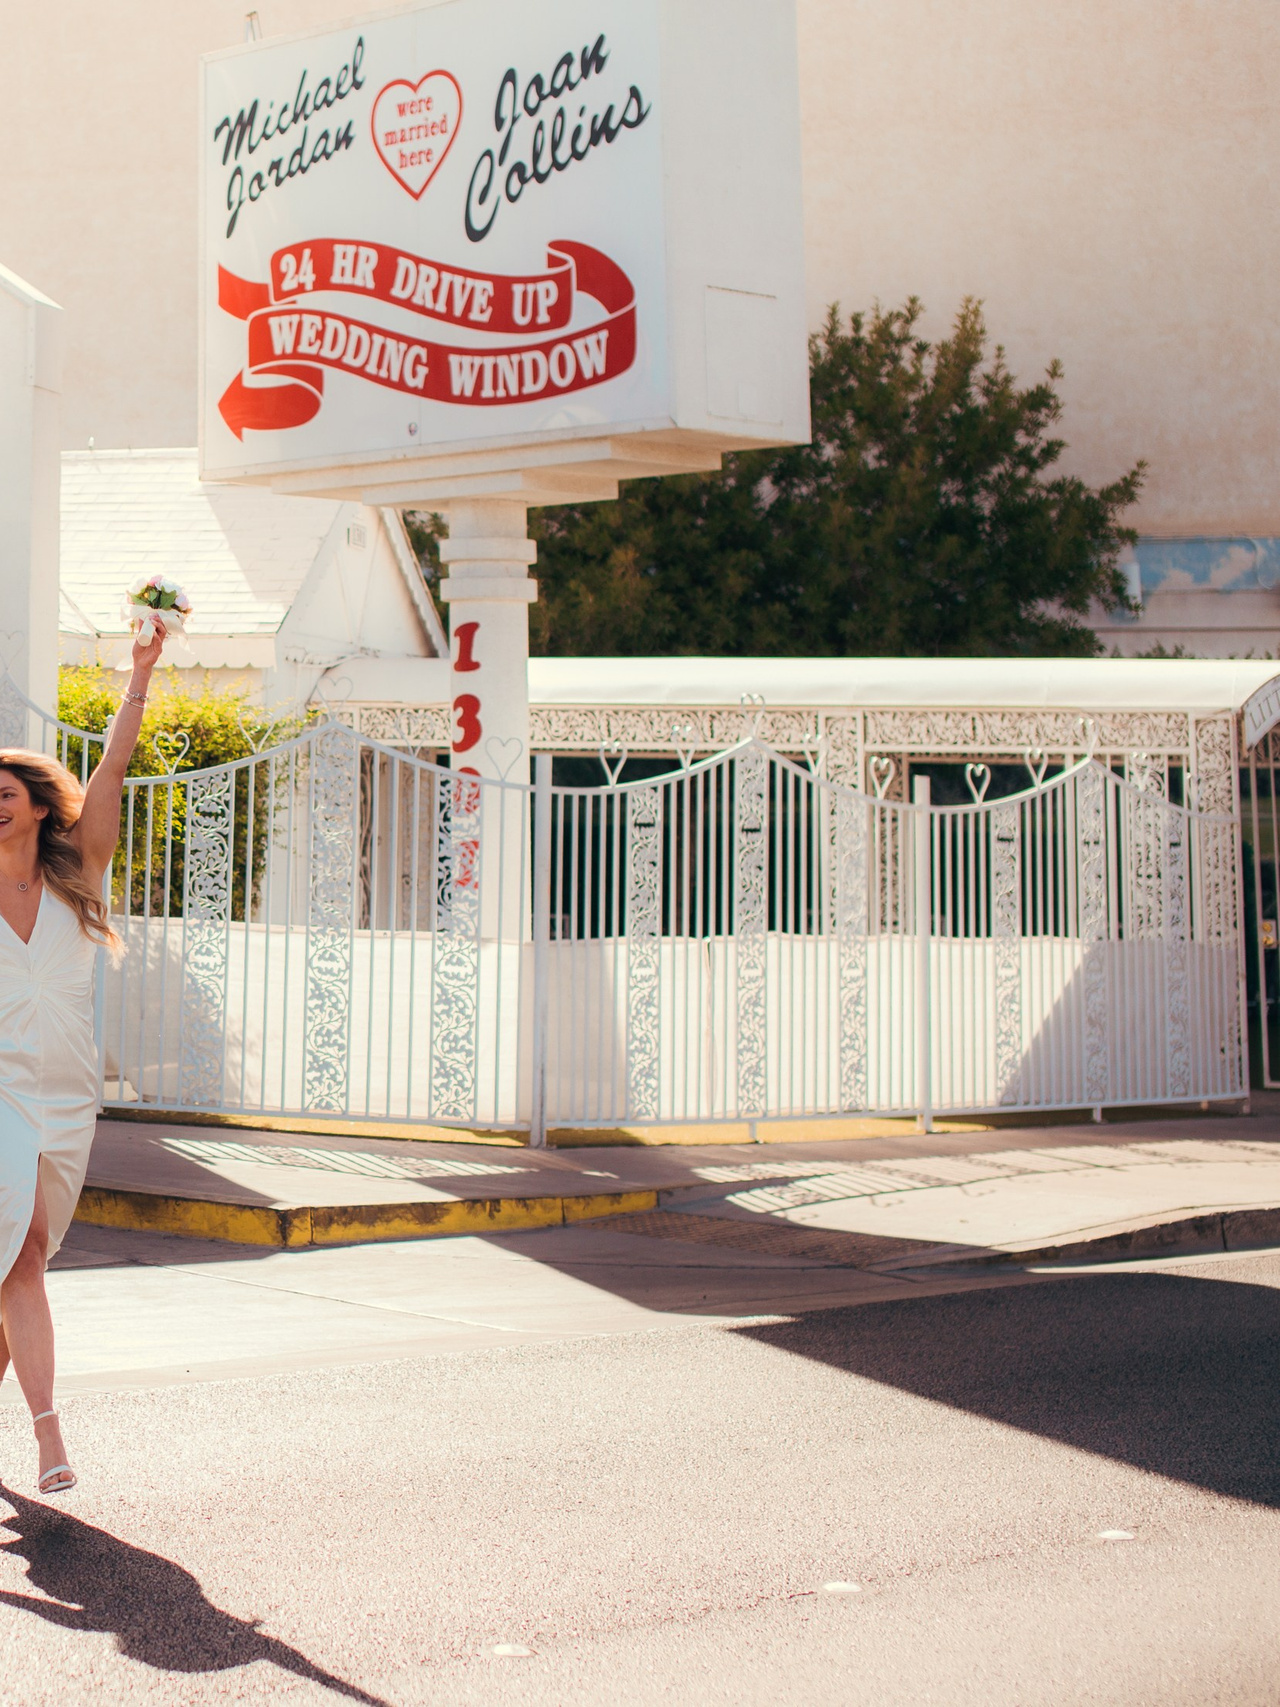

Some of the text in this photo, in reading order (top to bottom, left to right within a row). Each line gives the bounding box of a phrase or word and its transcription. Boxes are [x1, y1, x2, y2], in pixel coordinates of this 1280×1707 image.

[214, 36, 366, 166] Michael
[383, 113, 448, 146] married
[396, 94, 434, 117] were
[494, 33, 609, 168] Joan
[226, 118, 355, 239] Jordan
[398, 143, 434, 171] here
[464, 85, 652, 243] Collins
[279, 243, 560, 326] 24 HR DRIVE UP
[268, 314, 610, 399] WEDDING WINDOW
